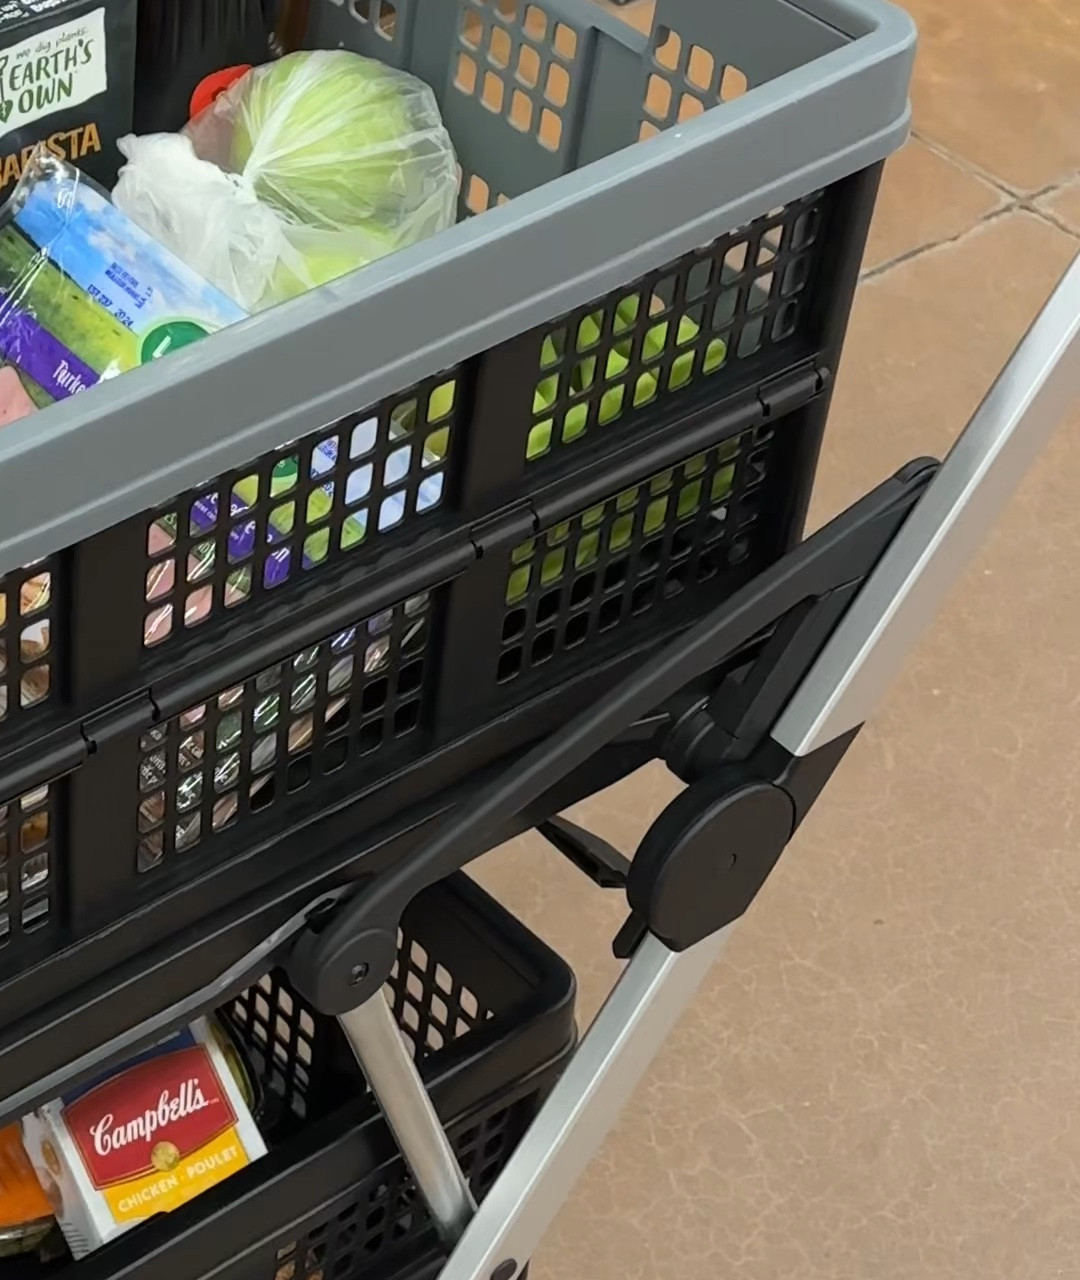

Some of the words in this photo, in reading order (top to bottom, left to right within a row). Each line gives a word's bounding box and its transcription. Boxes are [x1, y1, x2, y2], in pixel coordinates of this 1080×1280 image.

[8, 38, 94, 91] EARTH'S
[35, 40, 52, 54] dig
[18, 71, 73, 114] OWN
[52, 359, 88, 395] Turke
[89, 1077, 209, 1157] Campbell's
[118, 1173, 180, 1213] CHICKEN
[185, 1145, 239, 1185] POULET
